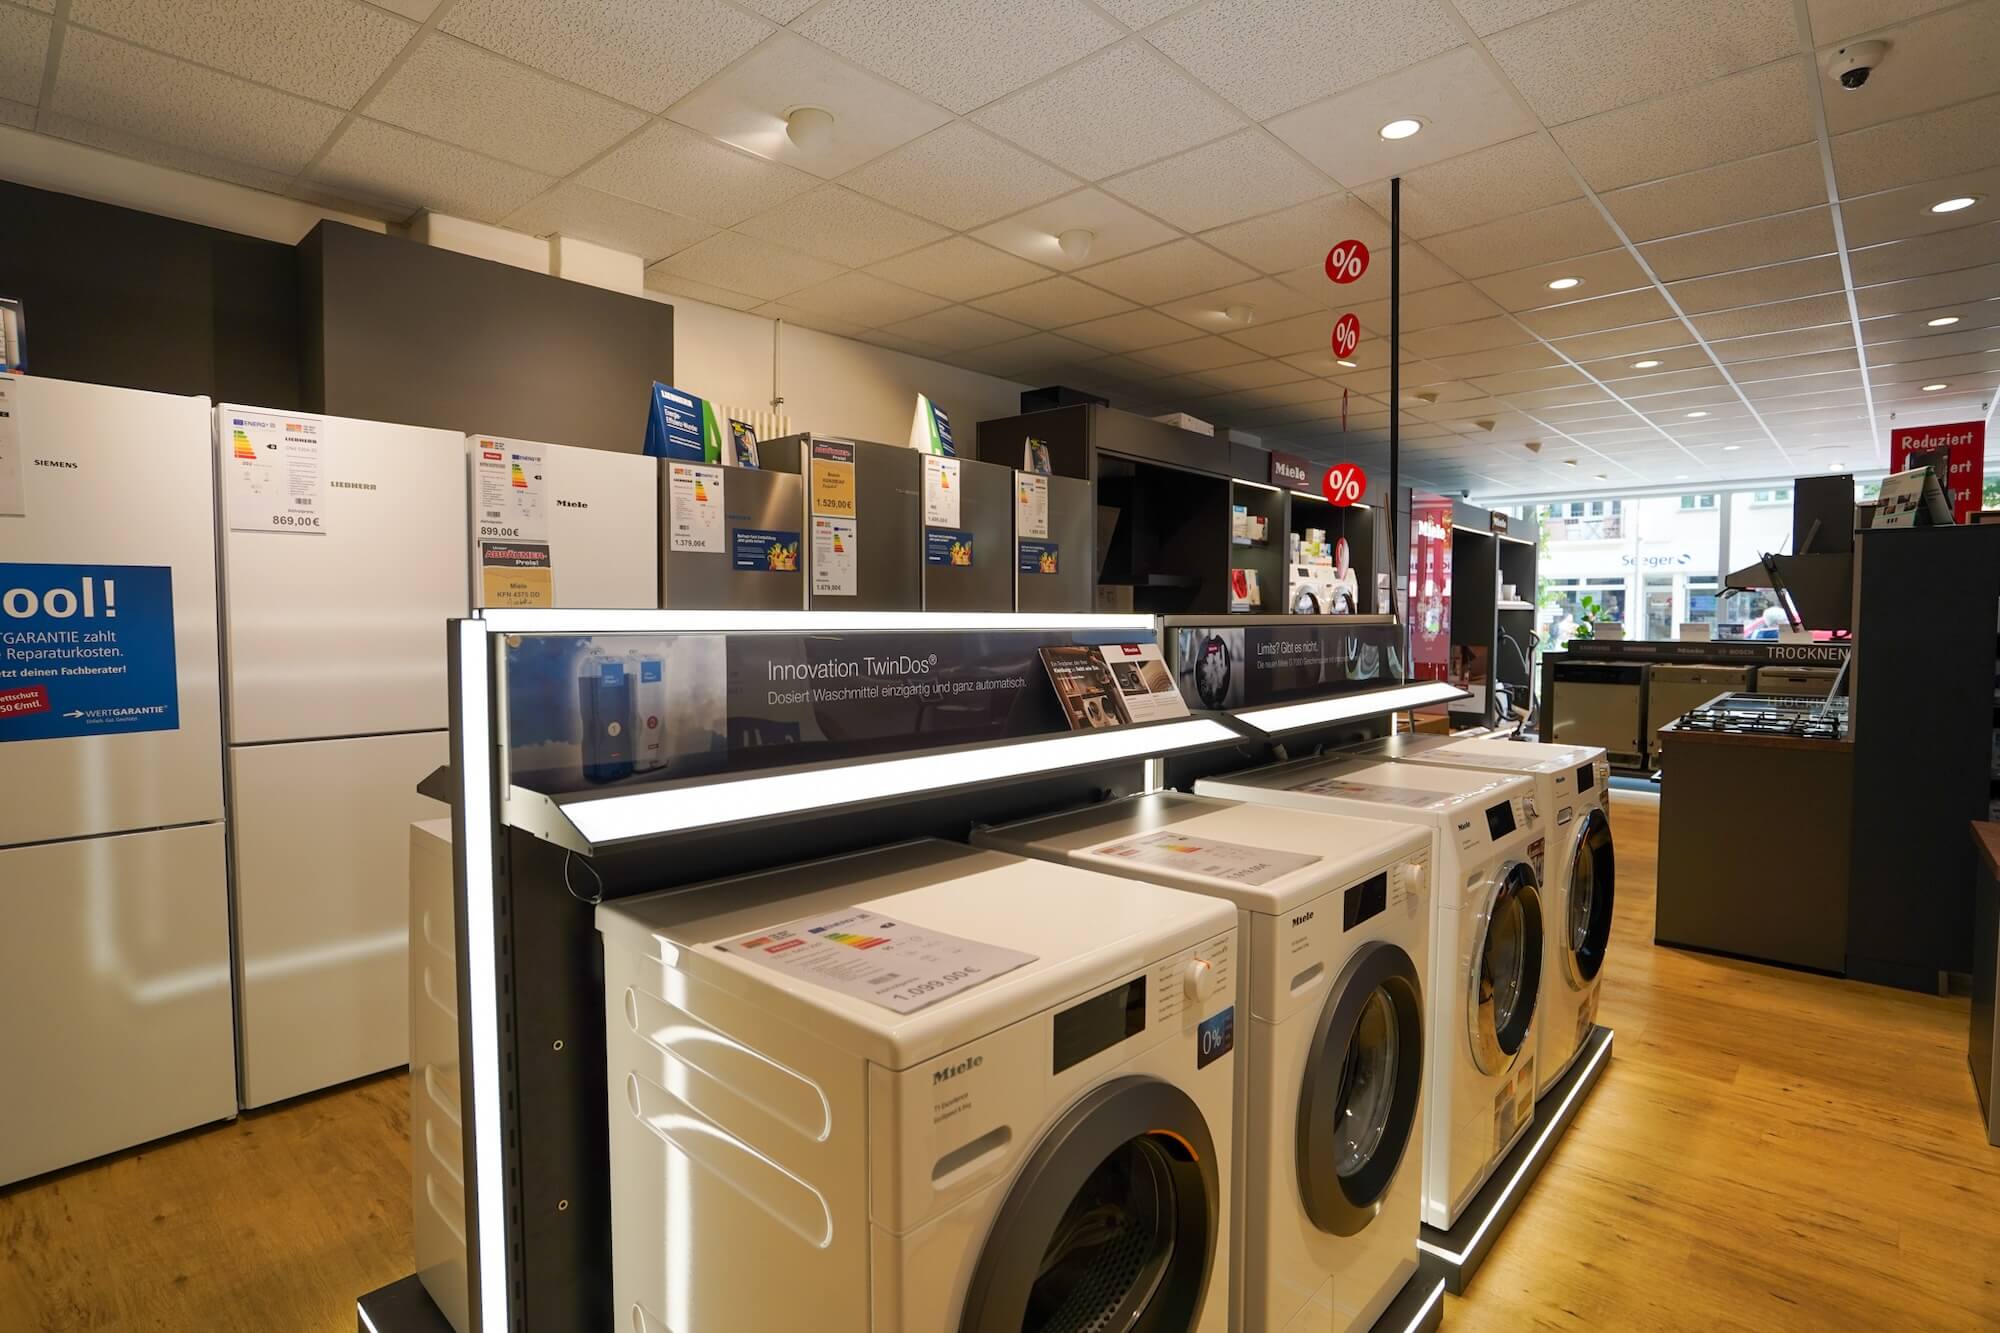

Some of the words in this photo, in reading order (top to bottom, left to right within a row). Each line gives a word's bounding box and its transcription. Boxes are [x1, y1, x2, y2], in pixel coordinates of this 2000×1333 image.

[1902, 432, 1974, 450] Reduziert
[34, 458, 78, 470] SIEMENS
[1275, 461, 1306, 482] Miele
[330, 480, 377, 491] LIEBHERR
[556, 500, 589, 510] Miele
[272, 515, 321, 527] 869,00€
[481, 526, 520, 537] 899,00€
[0, 631, 79, 645] GARANTIE
[83, 631, 116, 643] zahlt
[7, 646, 124, 661] Reparaturkosten.
[1257, 642, 1279, 656] Limits?
[1295, 643, 1302, 653] es
[20, 667, 58, 677] deinen
[61, 665, 127, 676] Fachberater!
[767, 659, 859, 681] Innovation
[767, 690, 811, 705] Dosiert
[813, 685, 879, 702] Waschmittel
[881, 682, 931, 699] einzigartig
[932, 680, 950, 694] und
[952, 680, 975, 695] ganz
[976, 677, 1029, 692] automatisch.
[1292, 910, 1314, 928] Miele
[892, 965, 982, 1002] 1.099,00€
[933, 1056, 983, 1085] Miele
